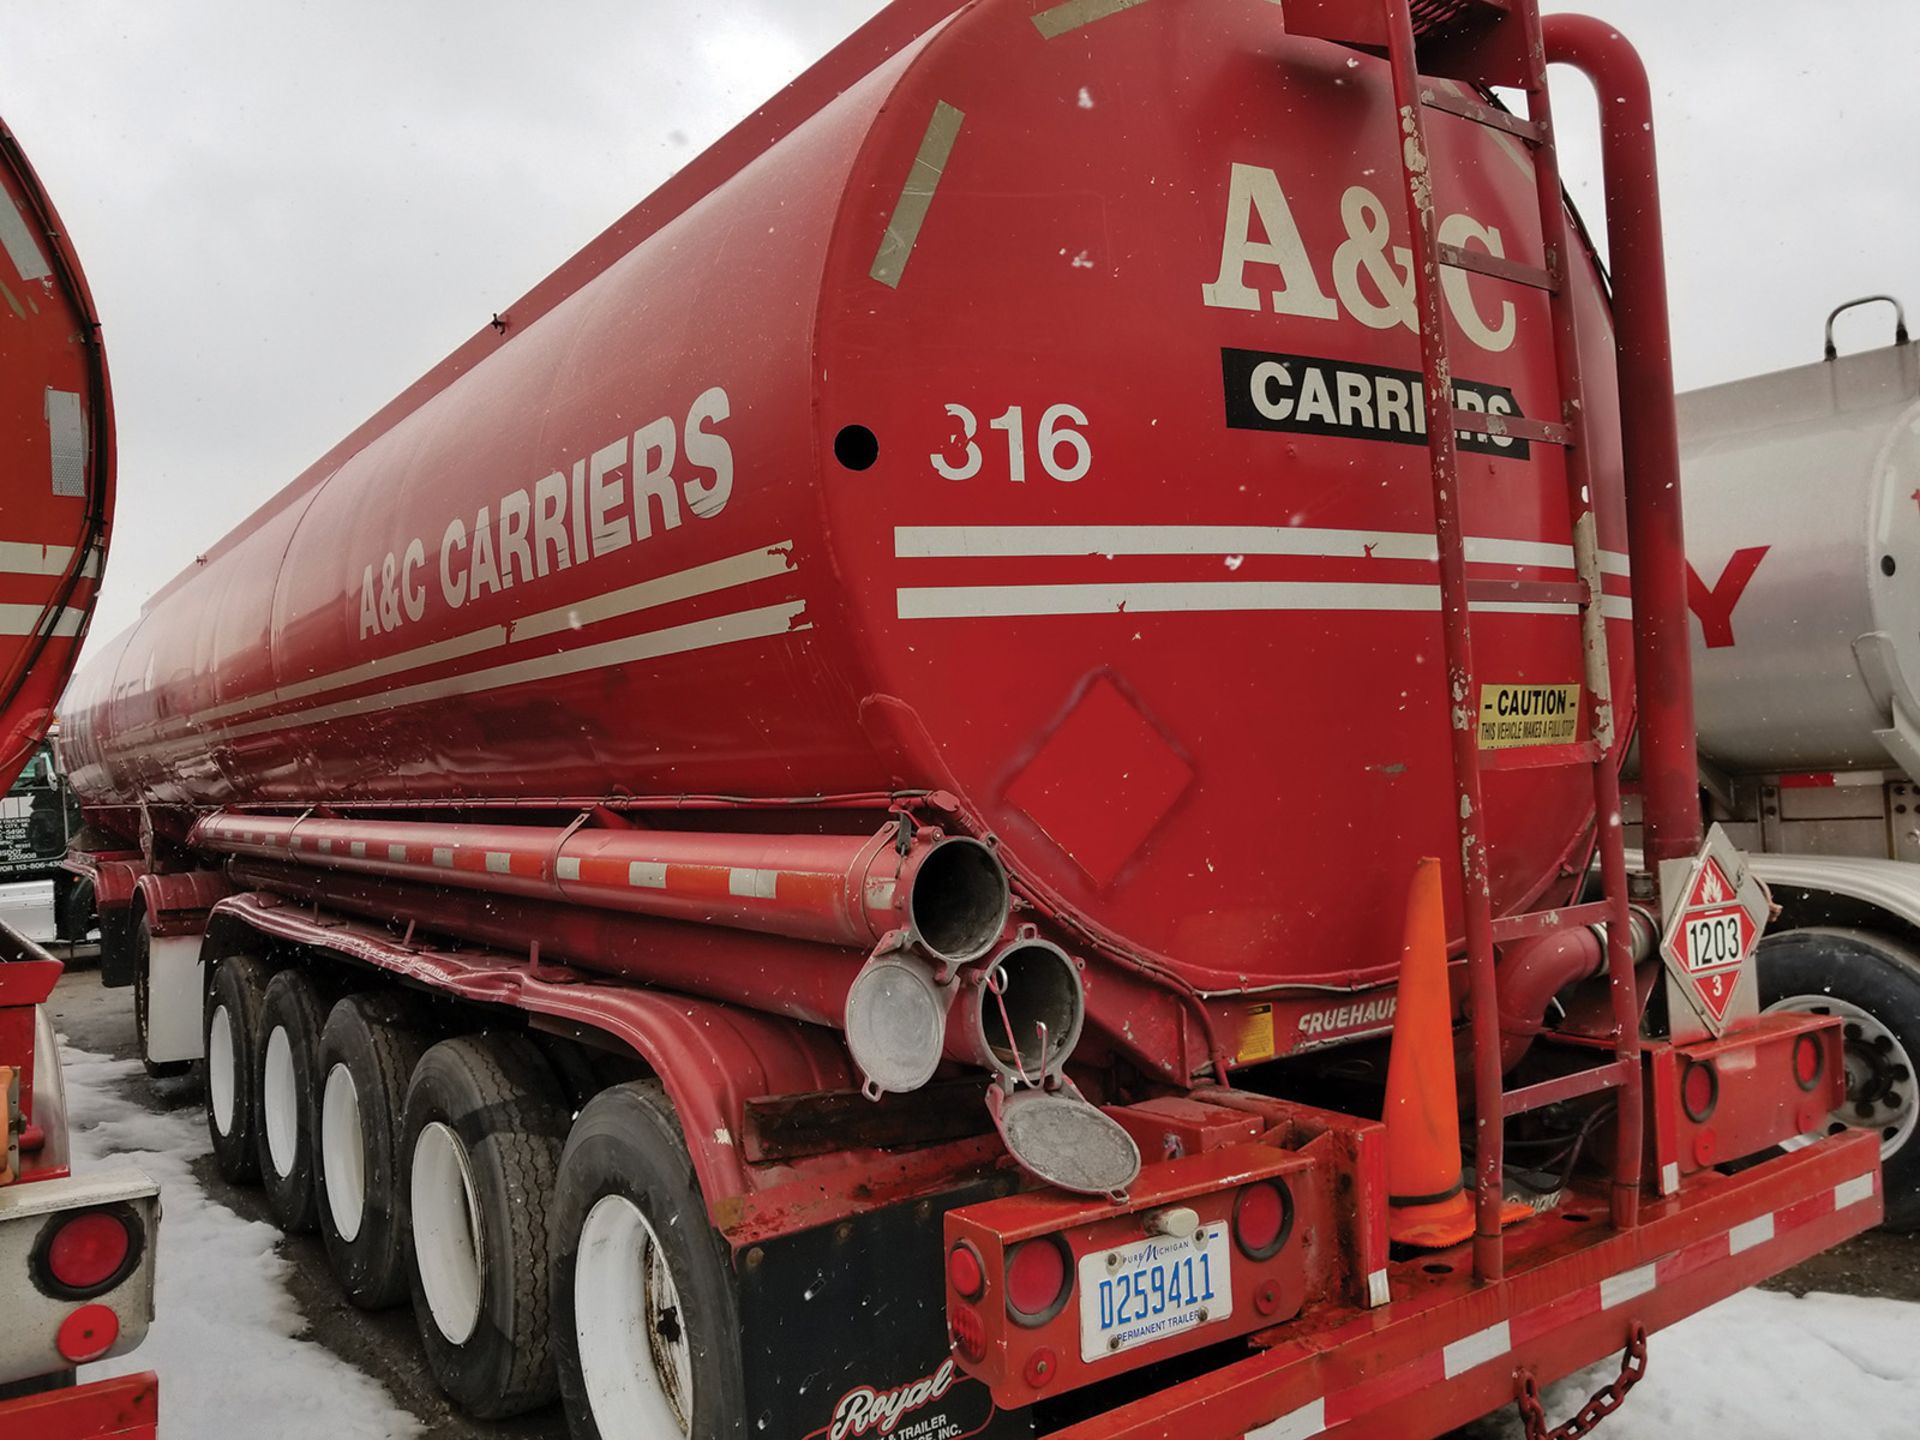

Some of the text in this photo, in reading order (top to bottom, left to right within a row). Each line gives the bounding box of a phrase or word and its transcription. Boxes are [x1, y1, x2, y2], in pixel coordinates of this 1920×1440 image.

[1201, 162, 1517, 352] A&C
[1250, 361, 1514, 448] CARRIRS
[930, 403, 1092, 482] 316
[359, 386, 734, 641] A&C CARRIERS
[1481, 722, 1496, 740] THIS
[1497, 721, 1522, 740] VEHICLE
[1523, 720, 1542, 738] MAKES
[1548, 720, 1561, 738] FULL
[1497, 689, 1567, 716] CAUTION
[1690, 917, 1740, 967] 1203
[1712, 974, 1723, 997] 3
[1099, 1252, 1215, 1330] D259411
[1117, 1309, 1200, 1343] PERMANENT TRAILER
[830, 1359, 954, 1440] Royal
[898, 1413, 947, 1440] TRAILER
